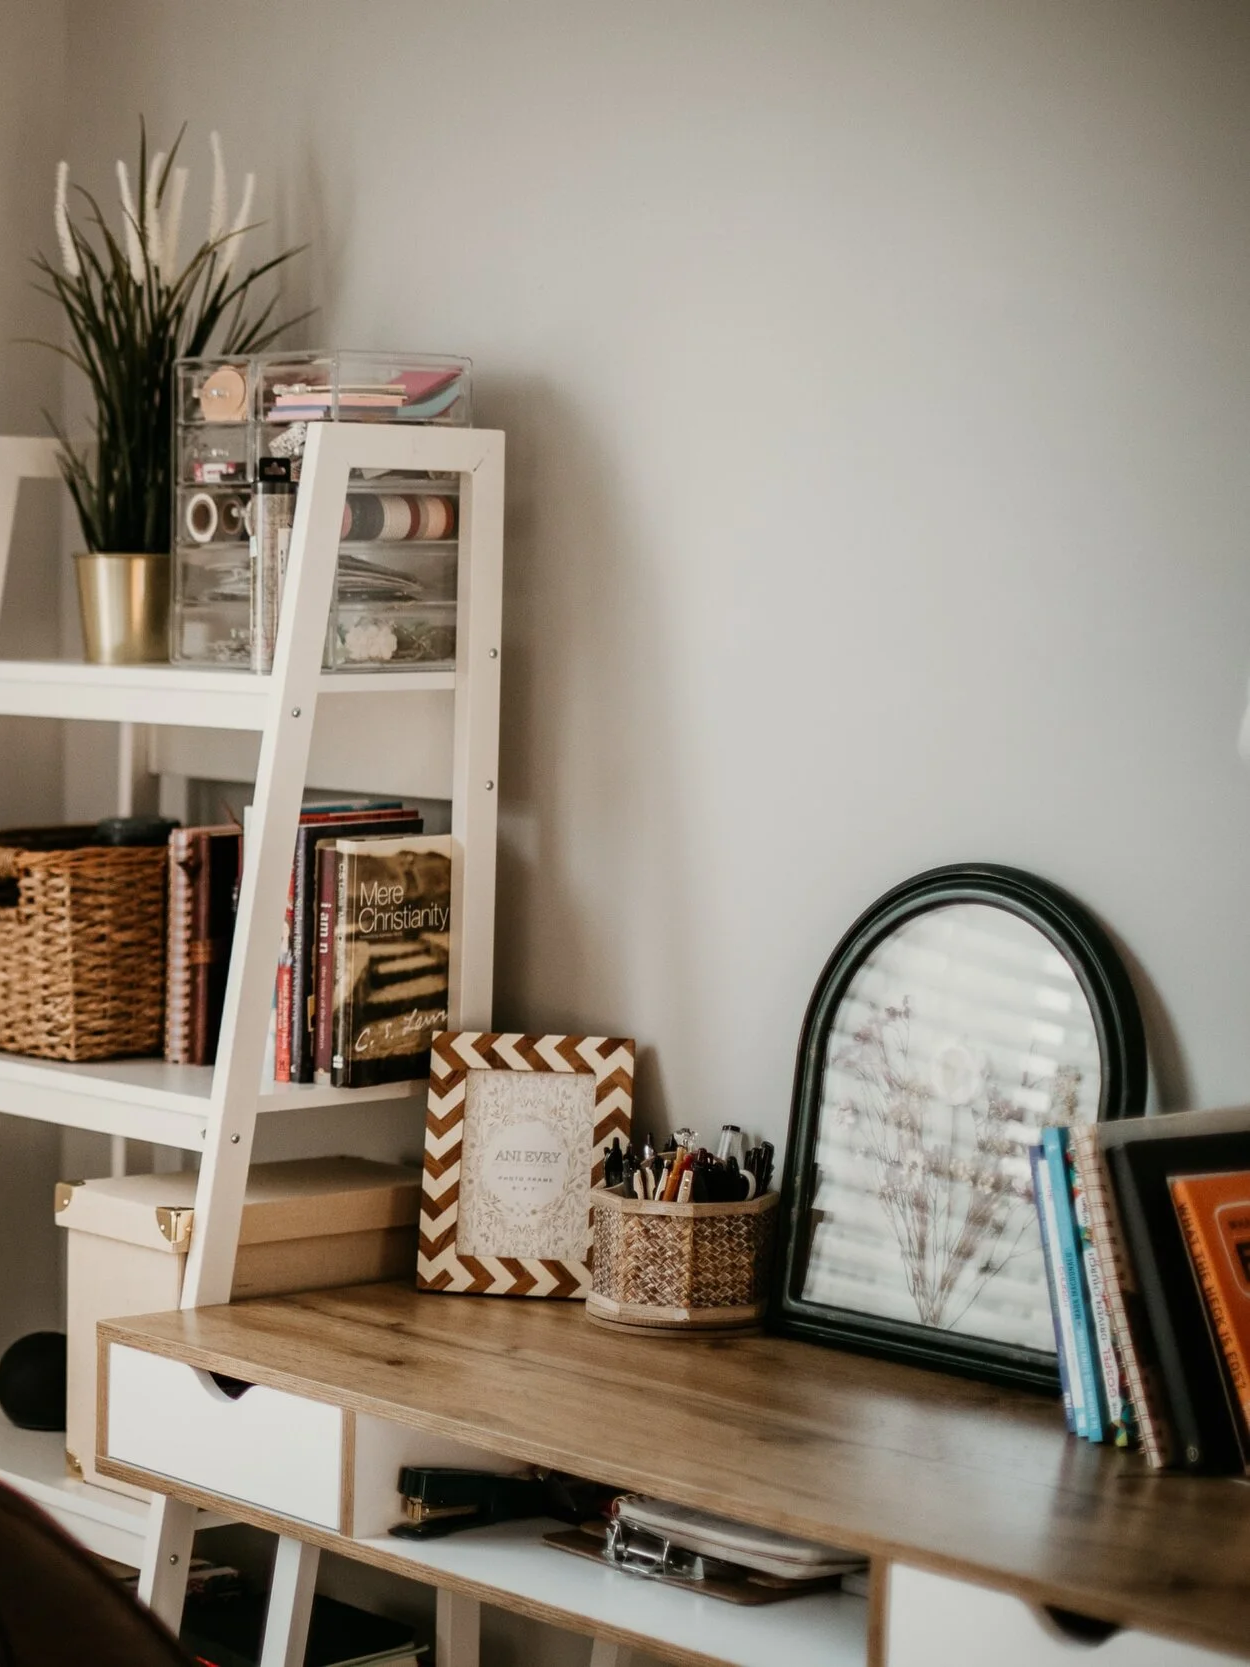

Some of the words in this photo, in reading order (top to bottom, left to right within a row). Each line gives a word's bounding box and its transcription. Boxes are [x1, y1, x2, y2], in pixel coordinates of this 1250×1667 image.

[359, 880, 405, 908] Mere
[319, 912, 330, 937] am
[357, 906, 450, 934] Christianity
[354, 1027, 375, 1052] C.
[384, 1022, 395, 1040] S.
[494, 1150, 522, 1161] ANI
[524, 1151, 562, 1164] EVRY
[1089, 1252, 1101, 1297] CHURCH
[1177, 1203, 1199, 1245] WHAT
[1193, 1254, 1211, 1278] THE
[1206, 1286, 1227, 1326] HECK
[1219, 1331, 1233, 1347] IS
